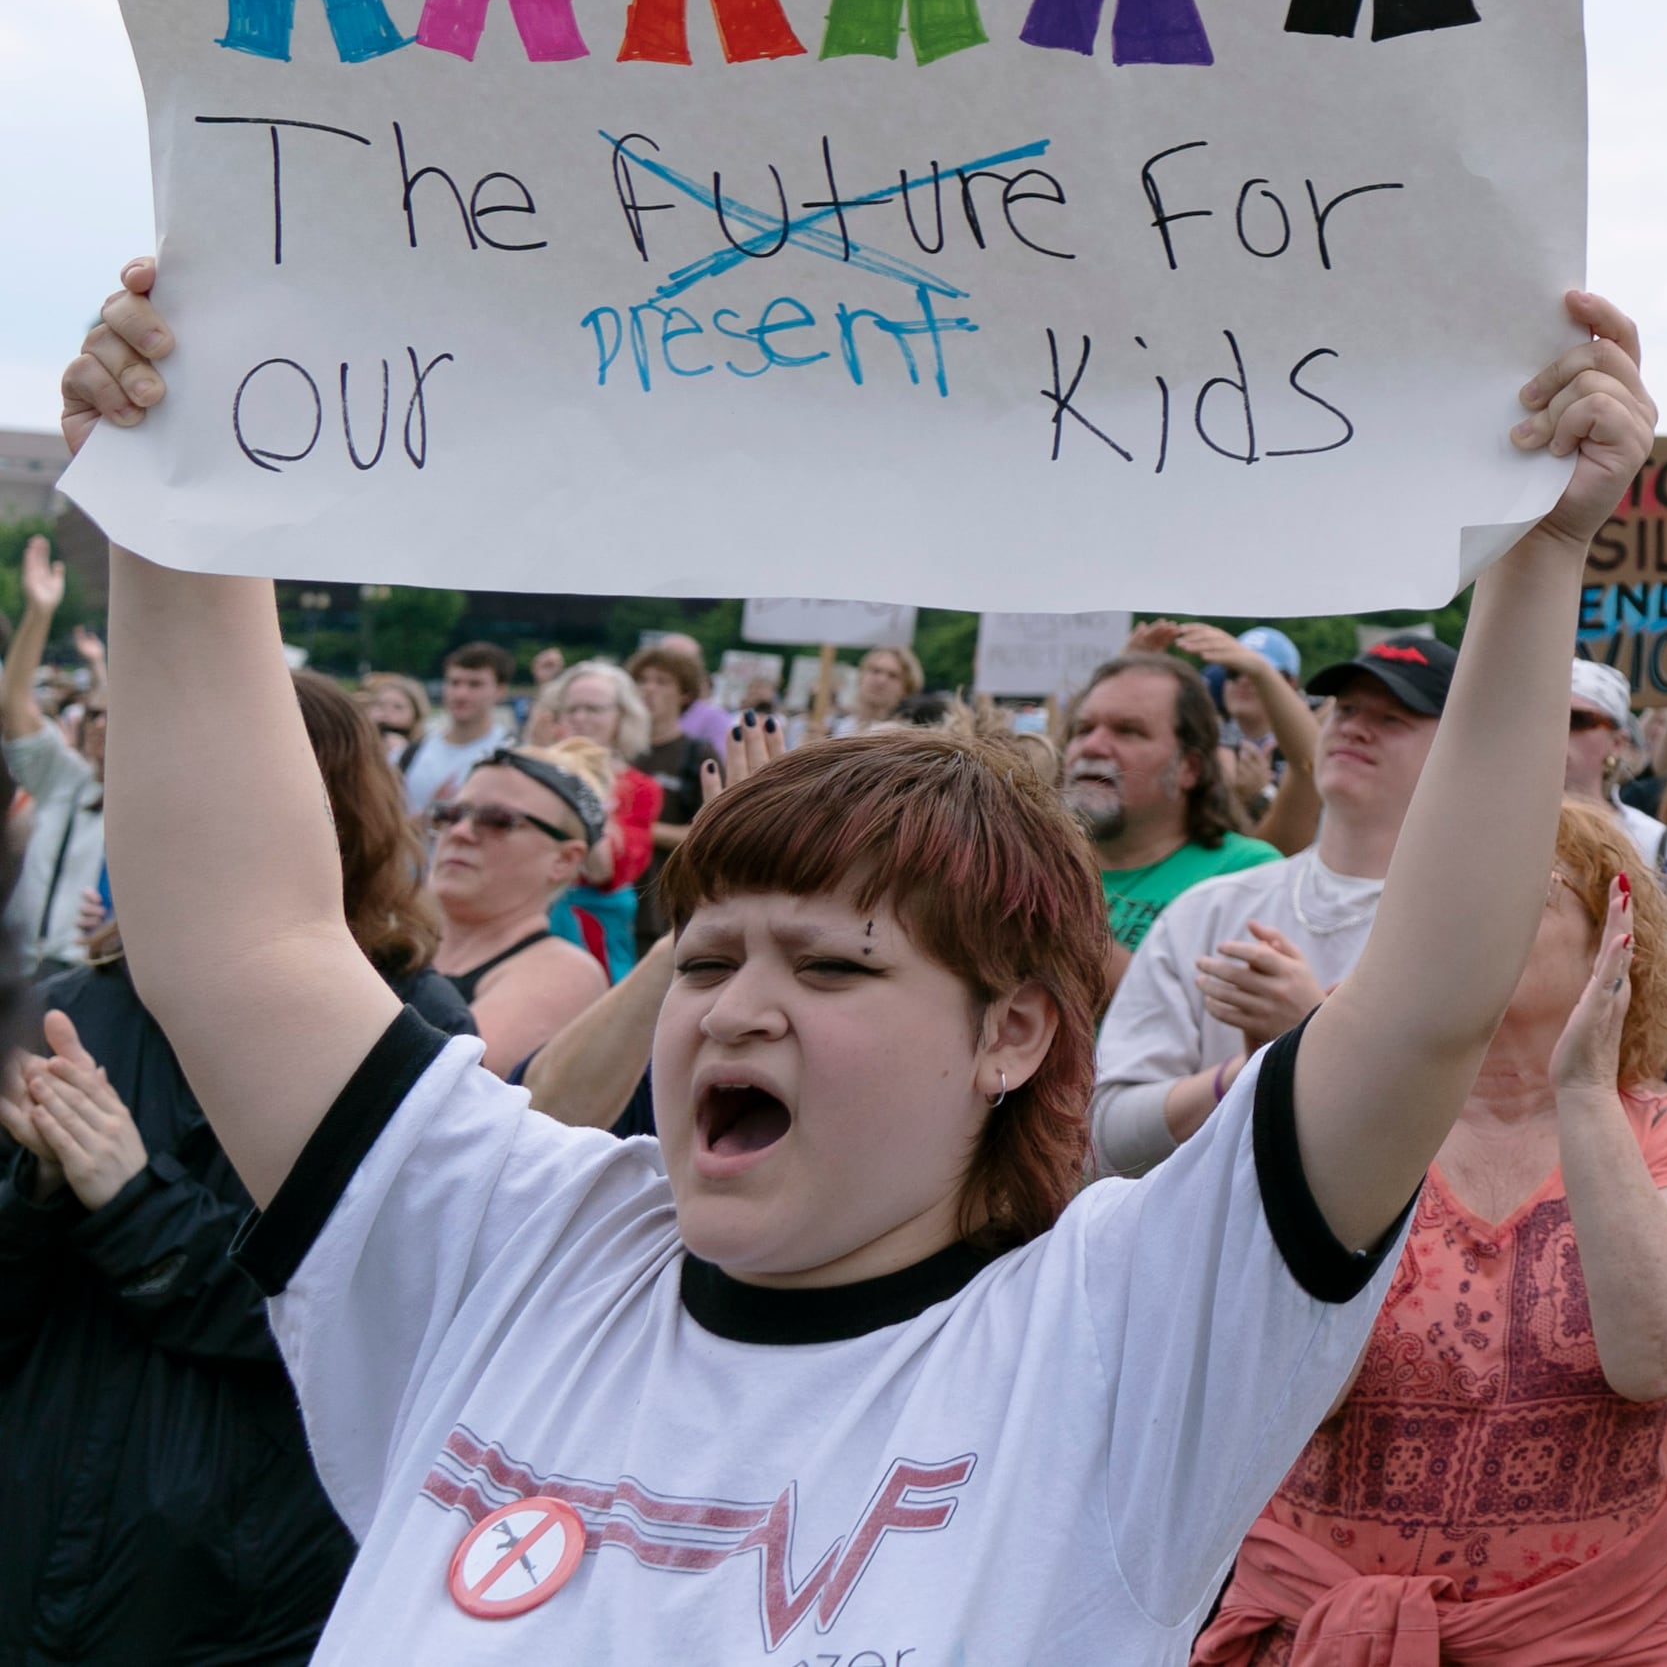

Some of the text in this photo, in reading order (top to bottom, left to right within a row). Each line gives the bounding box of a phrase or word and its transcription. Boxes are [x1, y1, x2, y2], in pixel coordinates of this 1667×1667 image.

[196, 117, 547, 263] The
[582, 285, 978, 397] present
[234, 346, 453, 472] our
